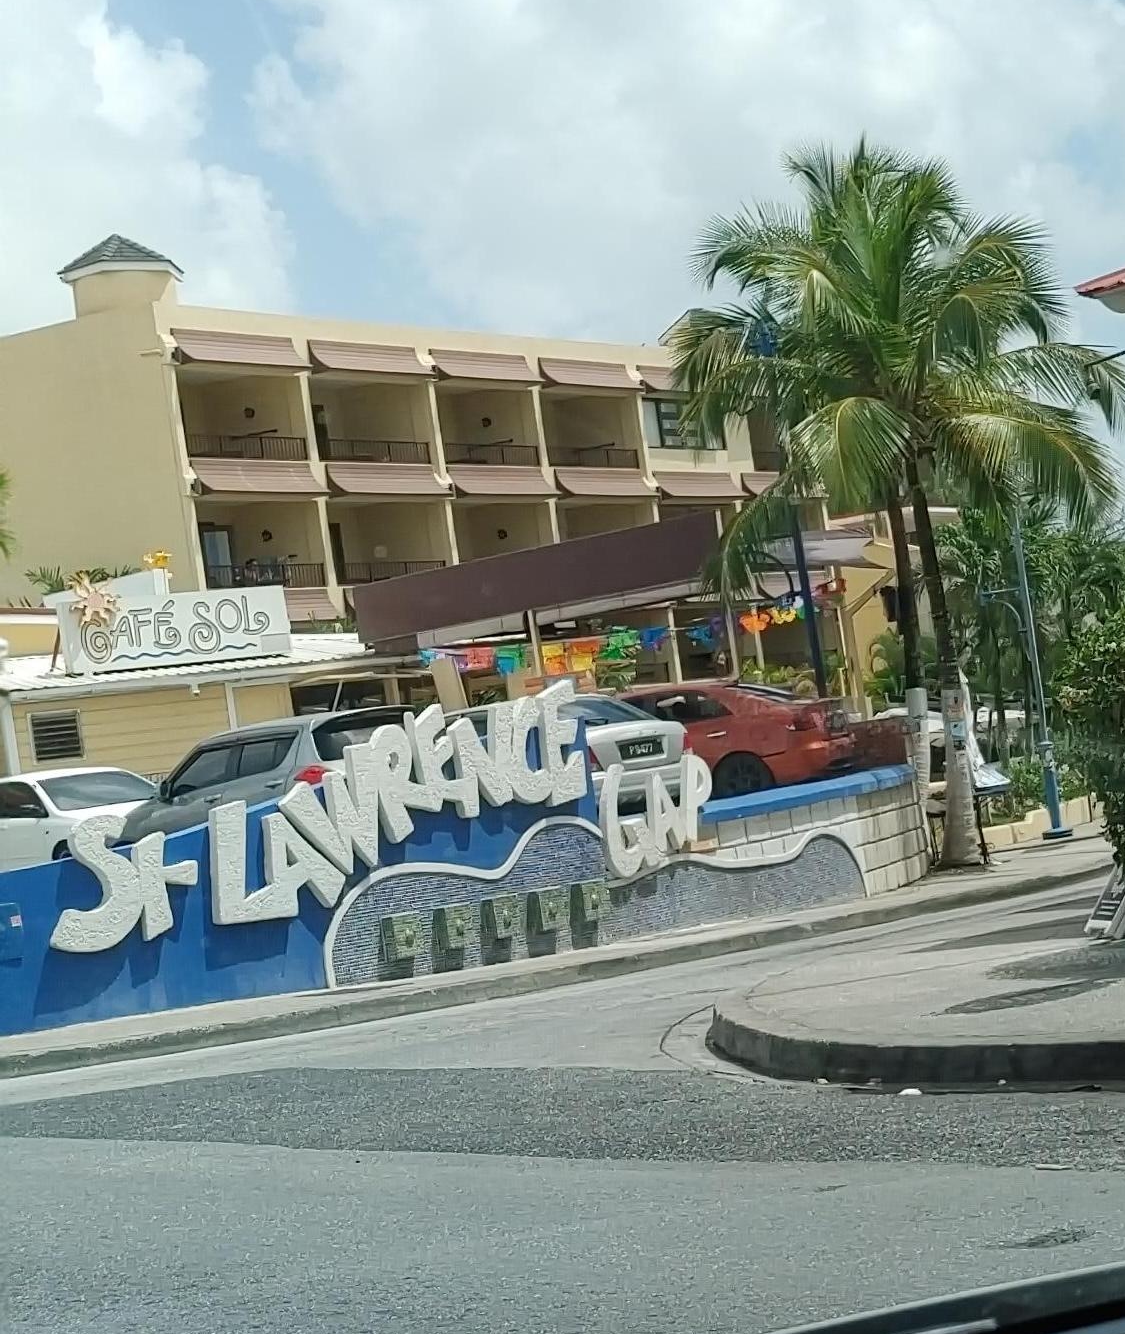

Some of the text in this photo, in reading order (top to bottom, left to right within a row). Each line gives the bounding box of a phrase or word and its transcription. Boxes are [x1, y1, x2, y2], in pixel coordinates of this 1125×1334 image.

[81, 595, 270, 664] CAFÉ SOL
[208, 679, 588, 925] LAWRENCE
[600, 753, 713, 878] GAP
